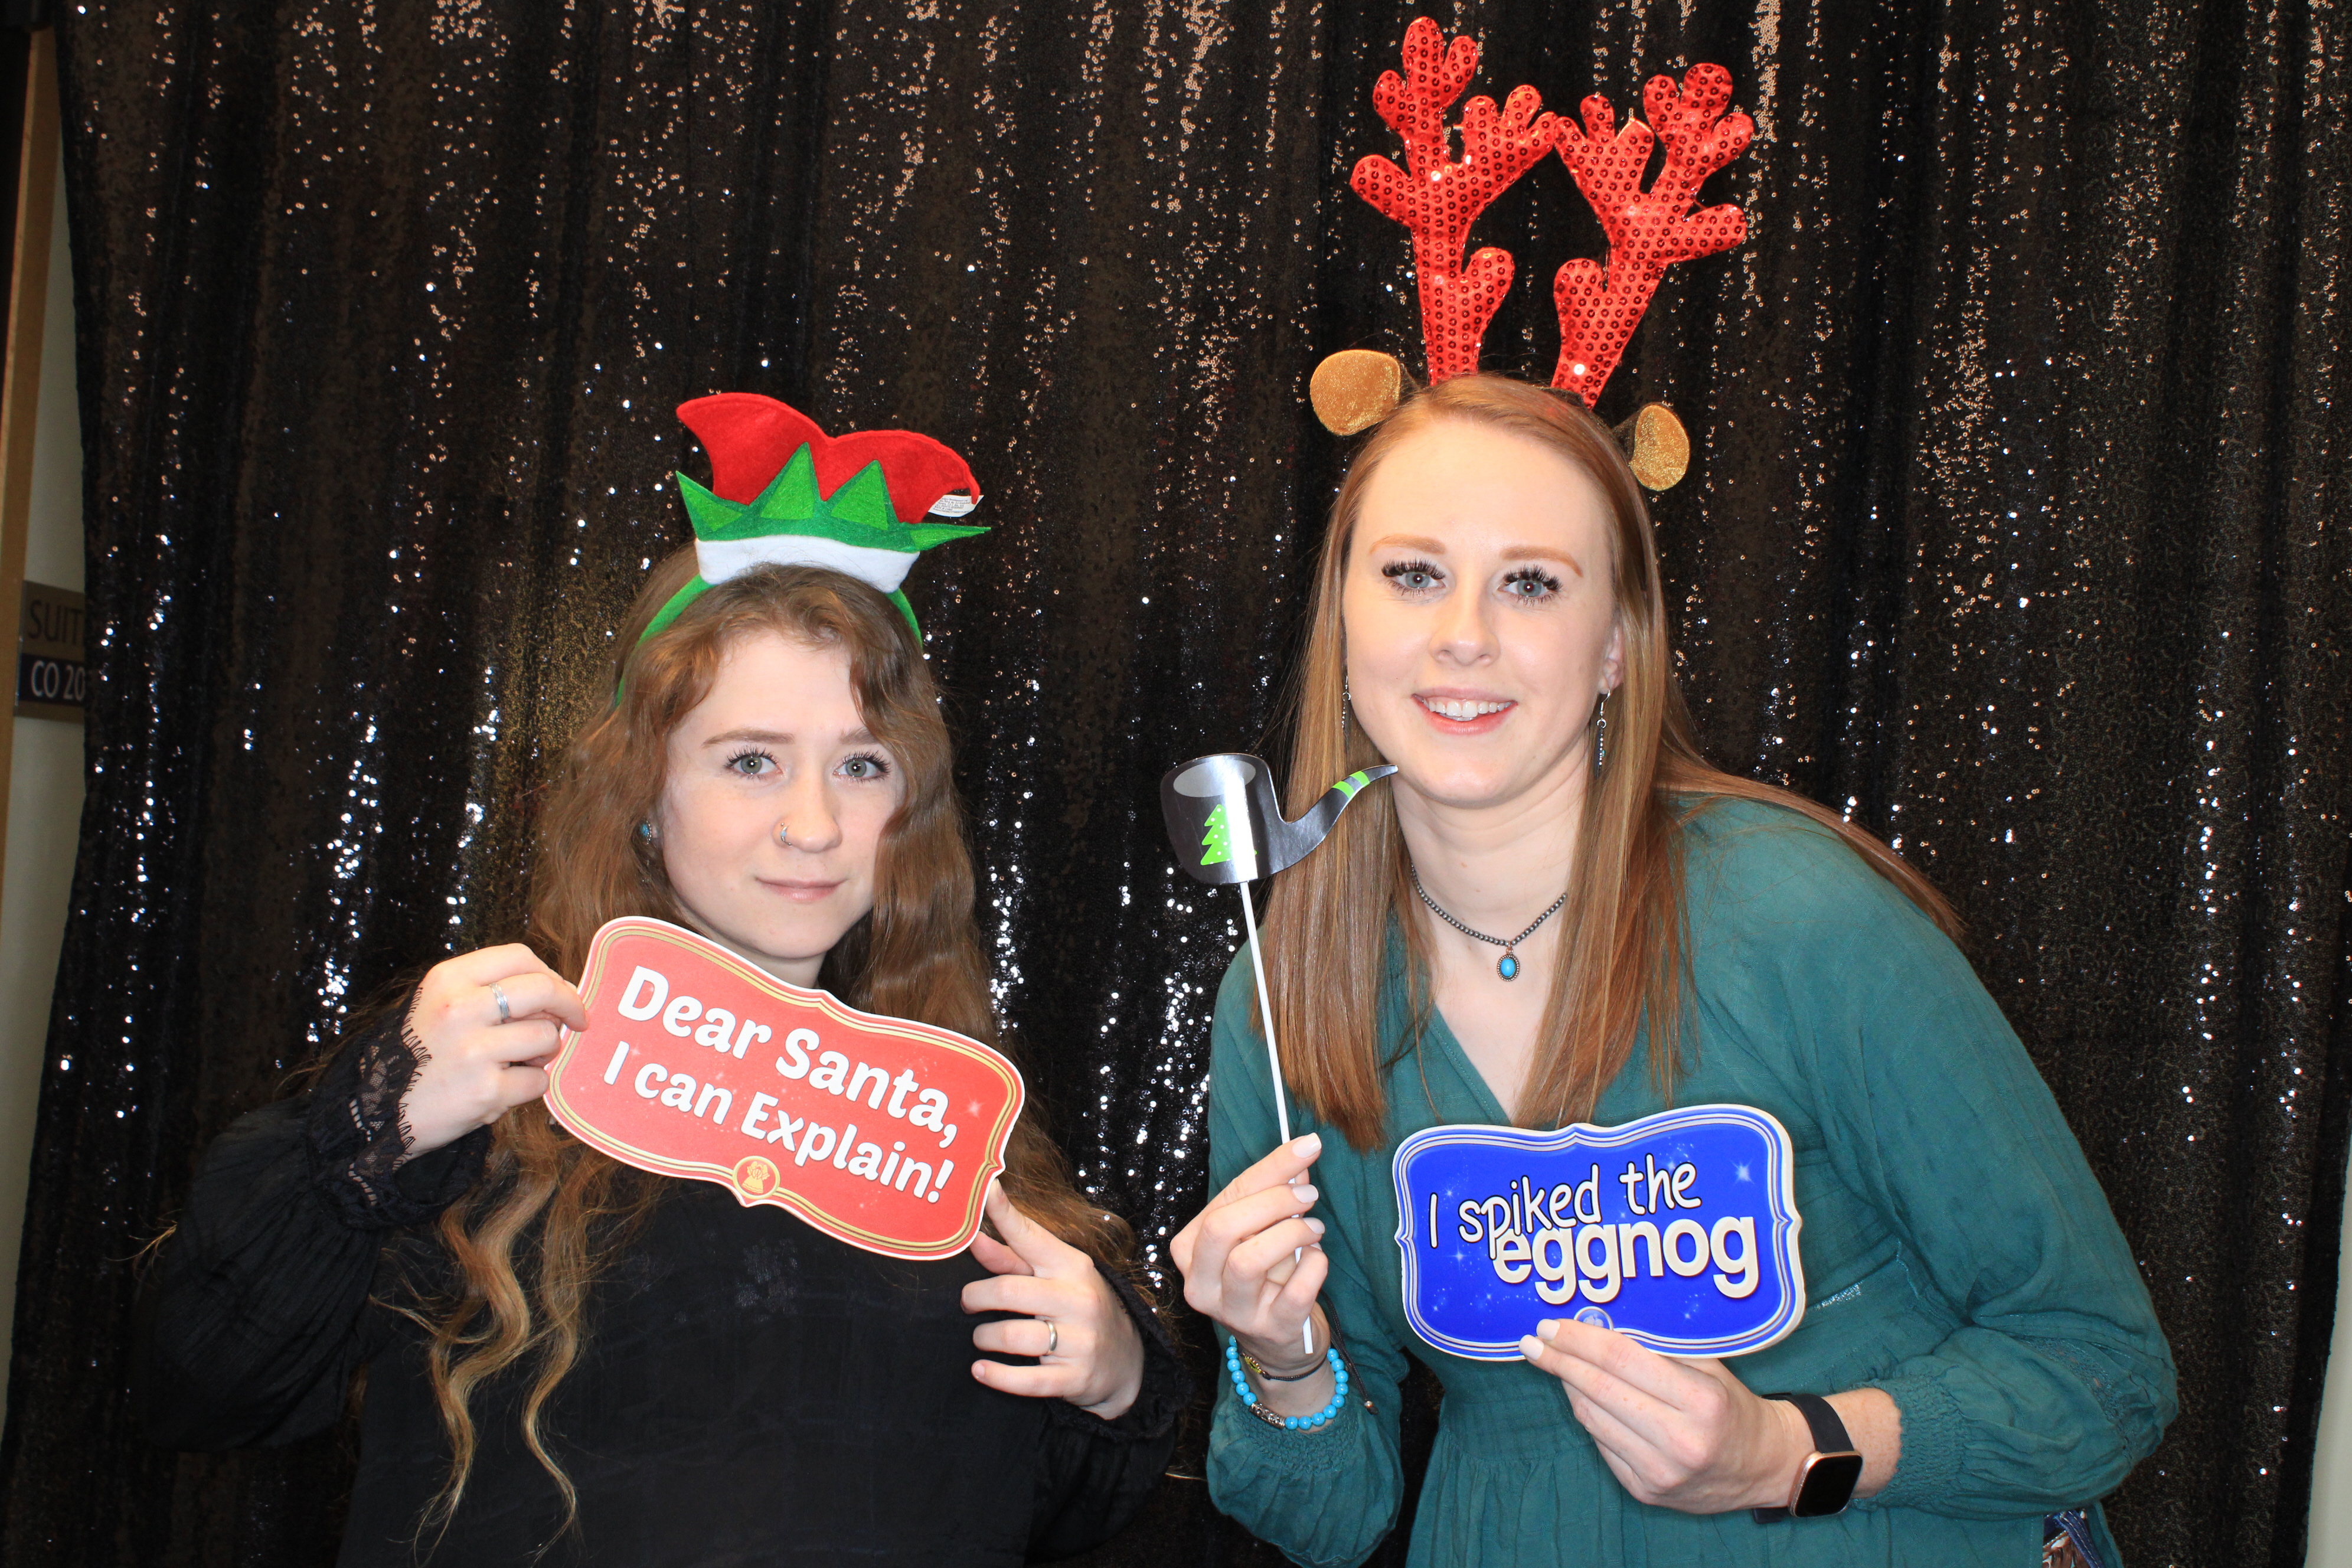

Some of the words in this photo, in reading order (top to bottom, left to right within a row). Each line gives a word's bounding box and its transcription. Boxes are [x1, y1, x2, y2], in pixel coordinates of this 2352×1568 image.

[28, 599, 85, 646] SUIT
[31, 659, 60, 699] CO
[617, 965, 773, 1060] Dear
[775, 1027, 958, 1148] Santa,
[603, 1040, 630, 1086] I
[635, 1063, 734, 1125] can
[740, 1091, 955, 1203] Explain!
[1429, 1193, 1439, 1249] I
[1458, 1163, 1602, 1260] spiked
[1619, 1153, 1703, 1216] the
[1492, 1216, 1760, 1305] eggnog
